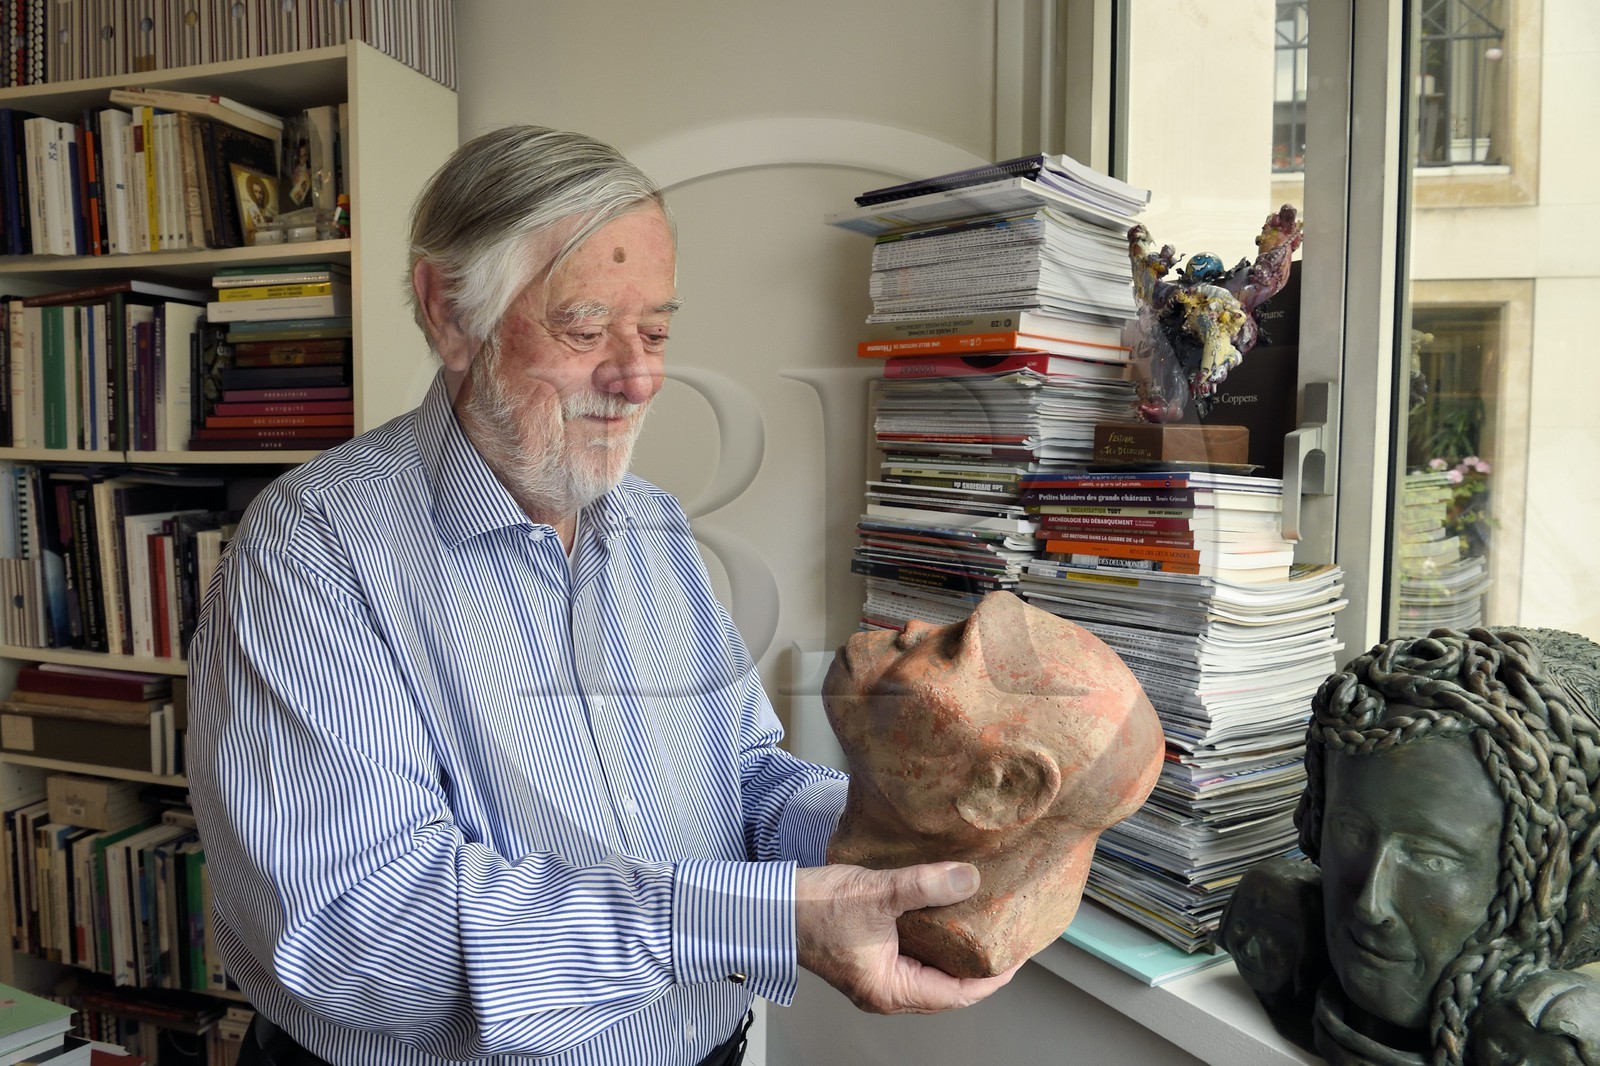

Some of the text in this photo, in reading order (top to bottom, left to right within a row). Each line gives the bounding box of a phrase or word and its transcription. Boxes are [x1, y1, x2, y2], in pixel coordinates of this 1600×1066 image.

[1261, 310, 1284, 320] mane
[866, 344, 892, 352] l'Homme
[898, 366, 936, 375] L'ODORAT
[1222, 393, 1258, 405] Coppens
[1108, 432, 1135, 444] FESTIVAL
[954, 481, 961, 489] du
[962, 481, 991, 491] DIVISIONS
[992, 483, 1004, 492] Les
[1038, 493, 1152, 503] Petites histoires des grands châteaux
[1048, 516, 1082, 524] ARCHÉOLOGIE
[1090, 517, 1133, 526] DÉBARQUEMENT
[1098, 558, 1110, 566] DES
[1110, 558, 1126, 567] DEUX
[1126, 559, 1149, 569] MONDES
